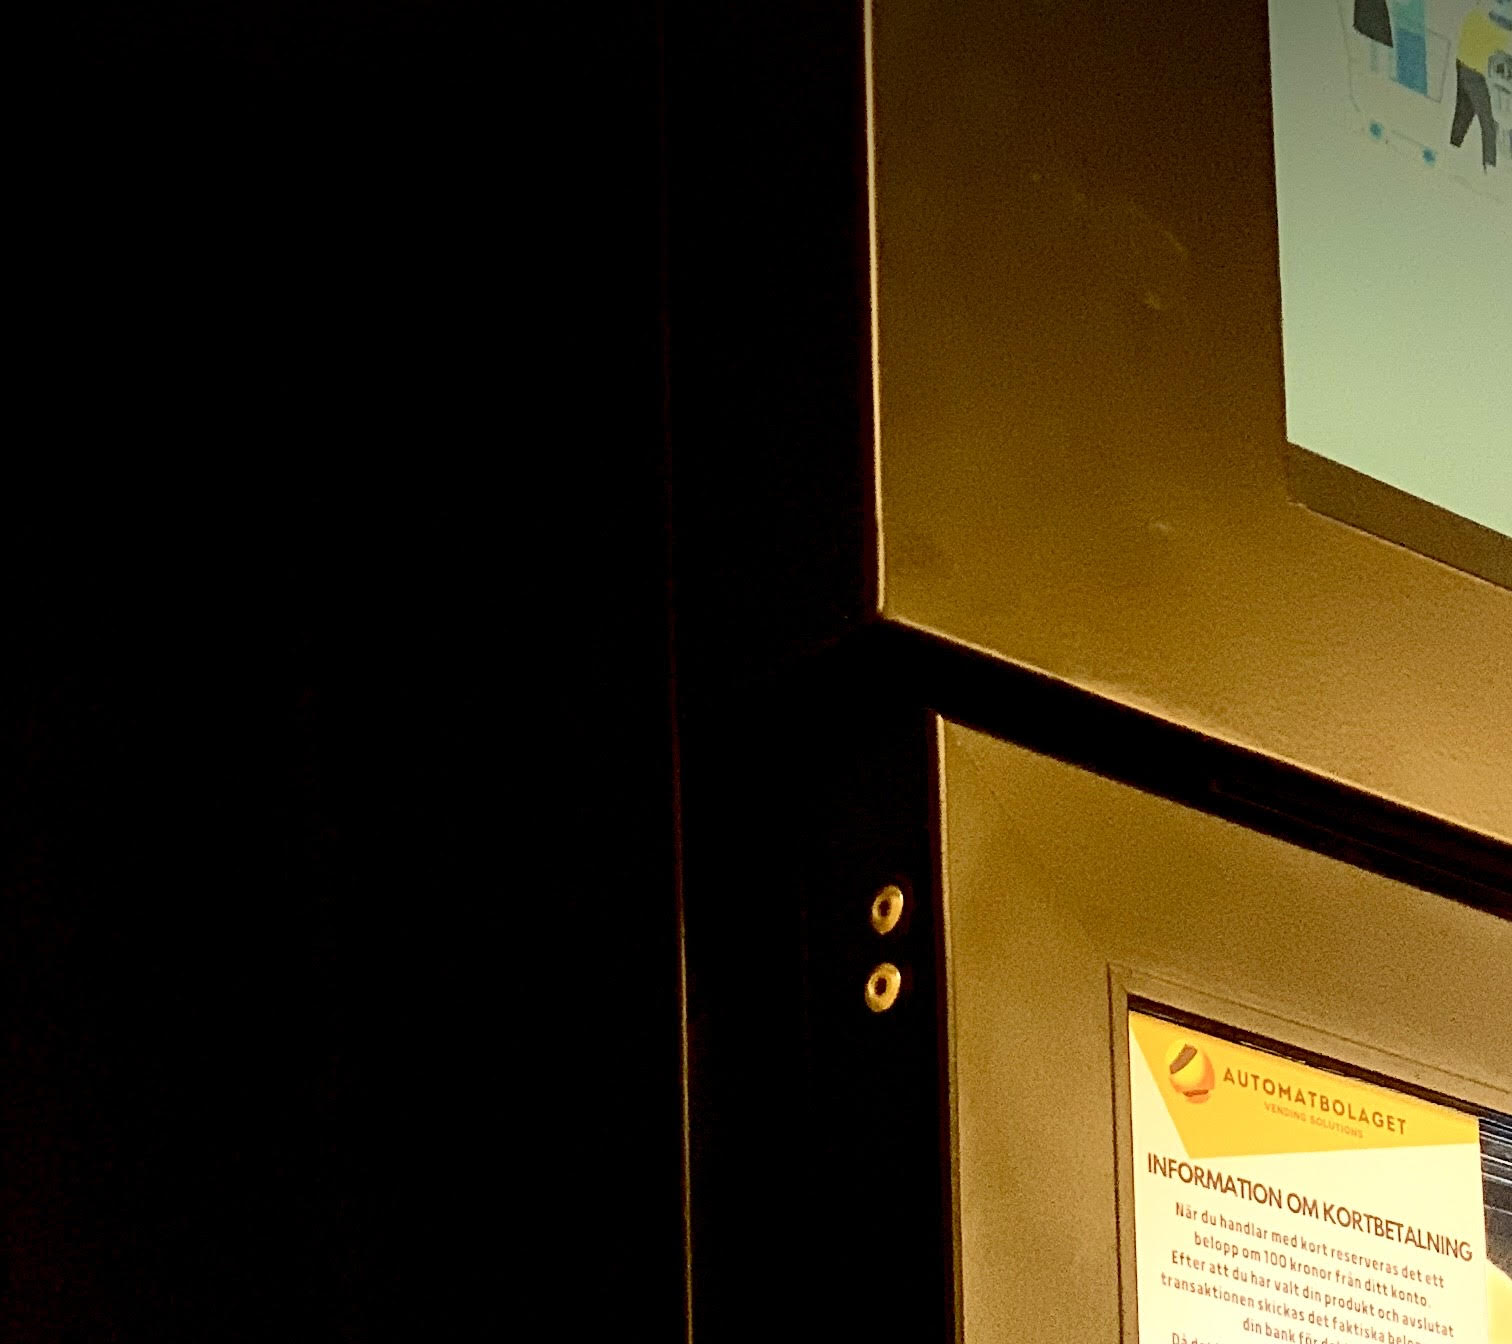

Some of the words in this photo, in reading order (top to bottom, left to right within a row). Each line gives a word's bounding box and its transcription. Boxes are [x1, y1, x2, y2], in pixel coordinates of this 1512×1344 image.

[1223, 1067, 1406, 1135] AUTOMATBOLAGET
[1148, 1152, 1283, 1209] INFORMATION
[1286, 1192, 1319, 1220] OM
[1323, 1202, 1473, 1262] KORTBETALNING
[1175, 1201, 1198, 1220] När
[1201, 1210, 1217, 1227] du
[1219, 1213, 1268, 1240] handlar
[1271, 1231, 1298, 1249] med
[1300, 1236, 1328, 1257] kort
[1330, 1248, 1399, 1276] reserveras
[1401, 1265, 1423, 1283] det
[1425, 1273, 1444, 1289] ett
[1194, 1231, 1239, 1259] belopp
[1241, 1247, 1261, 1262] om
[1263, 1250, 1287, 1269] 100
[1289, 1256, 1332, 1281] kronor
[1335, 1269, 1362, 1289] från
[1364, 1279, 1388, 1297] ditt
[1160, 1271, 1255, 1308] transaktionen
[1257, 1298, 1305, 1322] skickas
[1307, 1310, 1329, 1328] det
[1332, 1316, 1385, 1344] faktiska
[1171, 1250, 1206, 1271] Efter
[1209, 1263, 1229, 1278] att
[1232, 1266, 1248, 1283] du
[1250, 1270, 1271, 1289] har
[1274, 1280, 1300, 1297] valt
[1302, 1285, 1322, 1303] din
[1324, 1293, 1375, 1317] produkt
[1377, 1308, 1399, 1323] och
[1402, 1314, 1454, 1338] avslutat
[1242, 1317, 1262, 1335] din
[1265, 1321, 1296, 1343] bank
